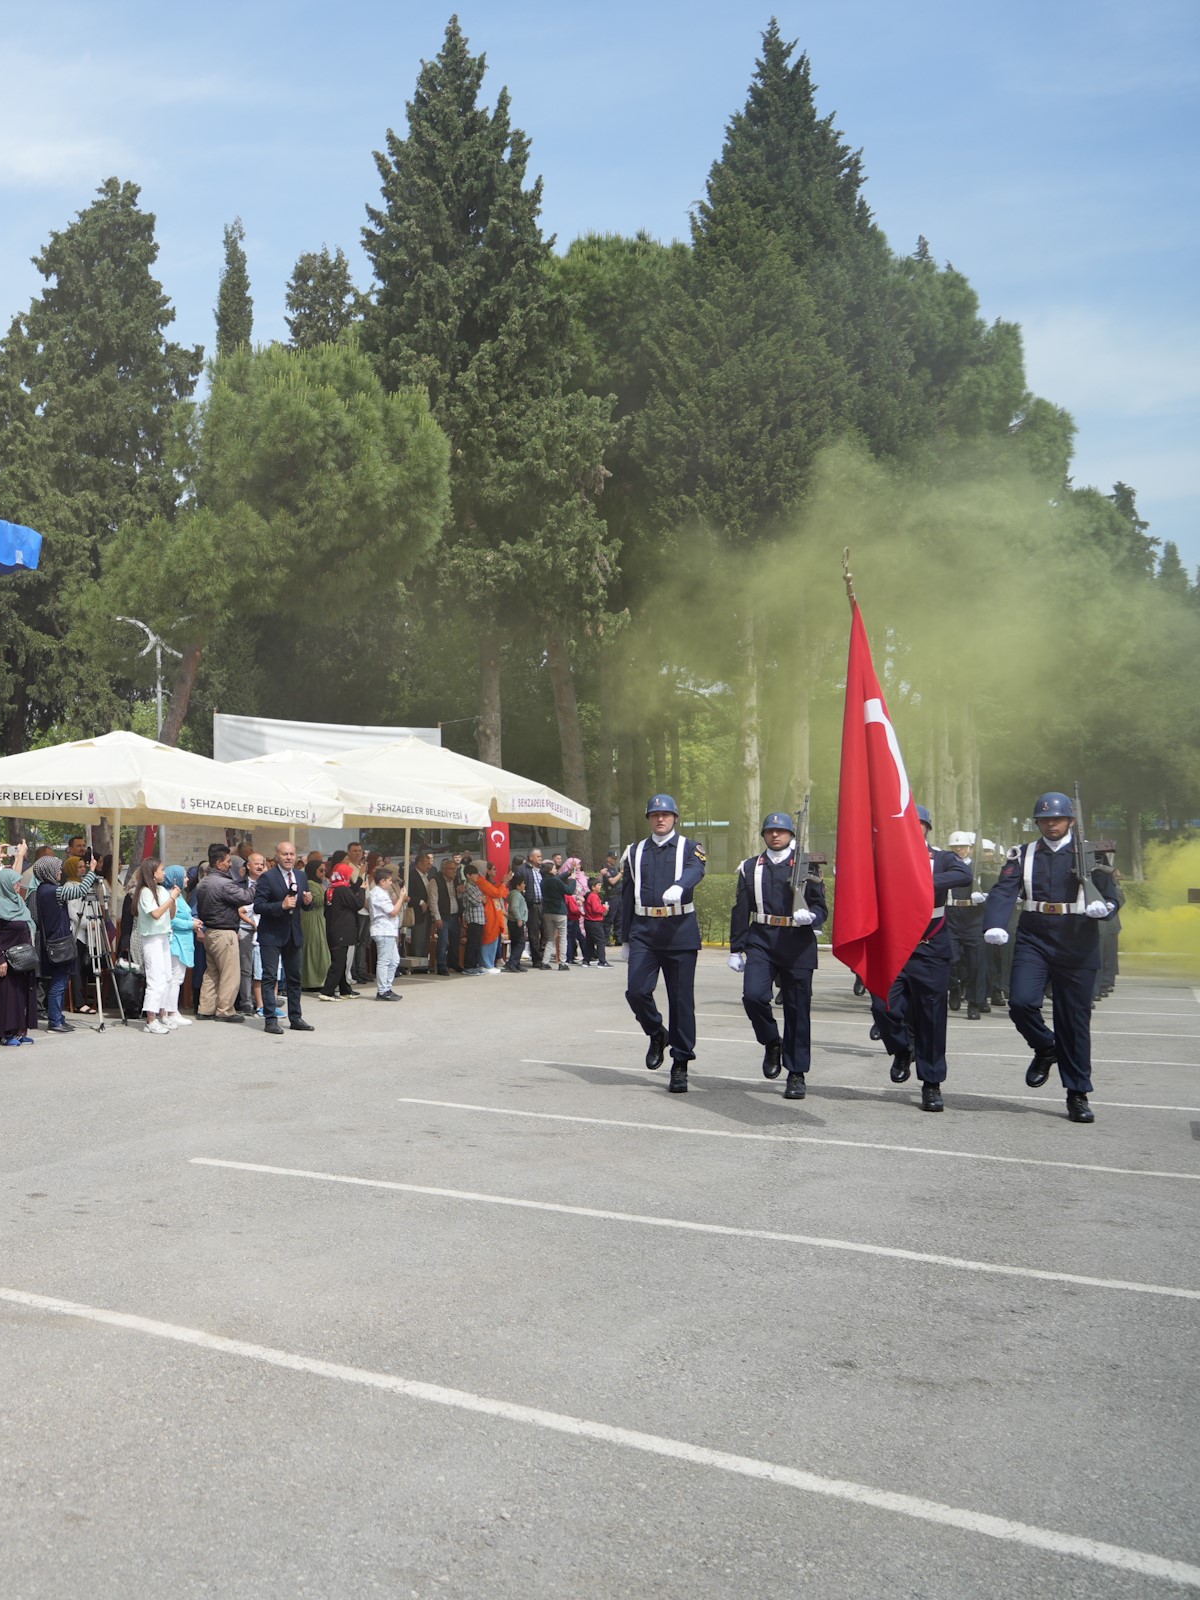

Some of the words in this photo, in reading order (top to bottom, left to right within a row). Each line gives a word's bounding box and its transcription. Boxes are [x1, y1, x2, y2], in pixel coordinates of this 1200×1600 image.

[13, 790, 83, 801] BELEDİYESİ
[190, 798, 254, 813] ŞEHZADELER
[257, 805, 309, 819] BELEDİYESİ
[377, 803, 424, 814] ŞEHZADELER
[425, 807, 463, 820] BELEDİYESİ
